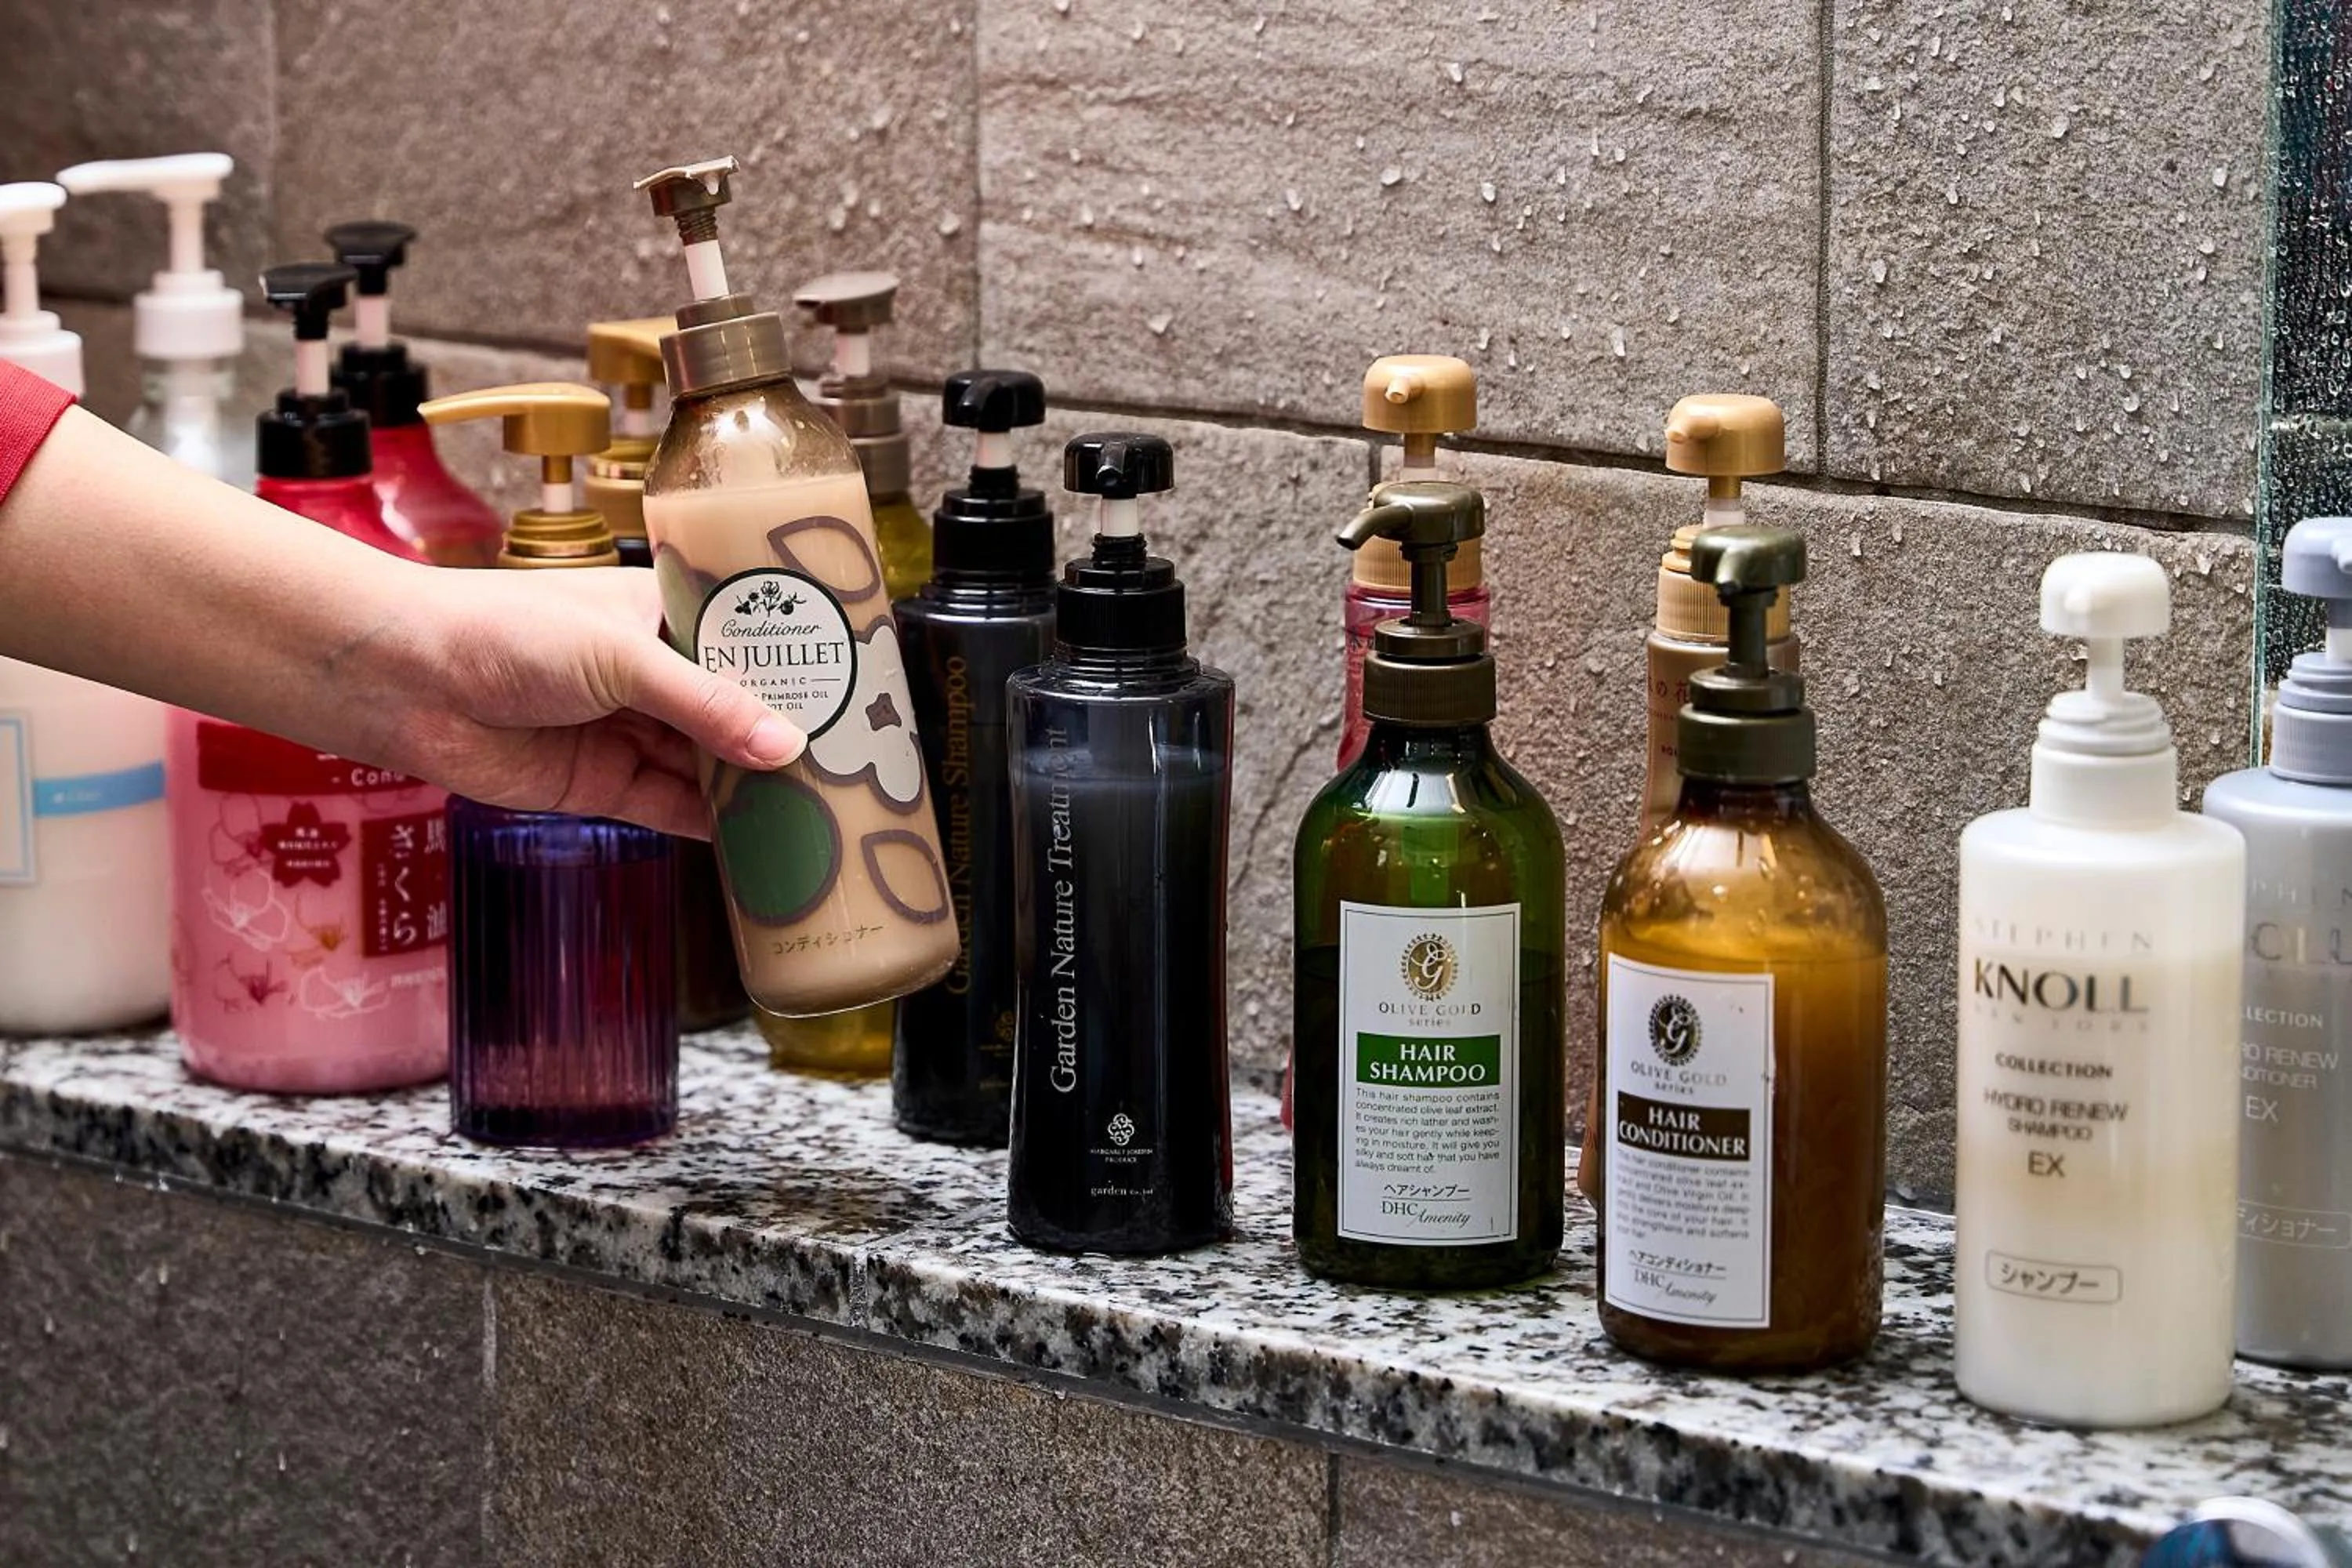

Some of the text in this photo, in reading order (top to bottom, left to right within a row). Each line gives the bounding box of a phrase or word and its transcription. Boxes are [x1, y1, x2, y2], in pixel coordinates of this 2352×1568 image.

[720, 619, 822, 637] Conditioner
[704, 642, 844, 674] EN JUILLET
[740, 677, 808, 688] ORGANIC
[761, 691, 808, 701] PRIMROSE
[942, 656, 976, 783] Shampoo
[947, 794, 971, 883] Nature
[390, 823, 417, 946] さくら
[1047, 727, 1076, 1094] Garden Nature Treatment
[771, 925, 884, 954] コンディショナー
[1974, 957, 2150, 1013] KNOLL
[1379, 1002, 1428, 1015] OLIVE
[1399, 1044, 1456, 1061] HAIR
[2266, 1046, 2339, 1069] RENEW
[1370, 1062, 1486, 1082] SHAMPOO
[1631, 1061, 1727, 1086] OLIVE GOLD
[1994, 1053, 2114, 1079] COLLECTION
[1356, 1087, 1499, 1103] This hair shampoo contains
[1356, 1102, 1417, 1114] concentrated
[1420, 1104, 1443, 1114] olive
[1648, 1106, 1700, 1131] HAIR
[2049, 1099, 2131, 1121] RENEW
[2245, 1095, 2279, 1122] EX
[1363, 1115, 1398, 1125] creates
[1399, 1116, 1418, 1126] rich
[1421, 1116, 1448, 1126] lather
[1451, 1116, 1470, 1126] and
[1368, 1126, 1389, 1136] your
[1392, 1127, 1410, 1136] hair
[1412, 1127, 1442, 1138] gently
[1445, 1128, 1470, 1138] while
[2007, 1117, 2093, 1141] SHAMPOO
[1441, 1141, 1458, 1149] will
[1461, 1142, 1481, 1152] give
[1483, 1140, 1500, 1150] you
[1619, 1120, 1745, 1155] CONDITIONER
[1355, 1160, 1385, 1171] always
[1376, 1149, 1394, 1160] and
[1396, 1151, 1414, 1160] soft
[1437, 1152, 1456, 1163] that
[1459, 1152, 1476, 1163] you
[1478, 1151, 1500, 1160] have
[2027, 1149, 2066, 1178] EX
[1384, 1183, 1470, 1197] ヘアシャンプー
[1381, 1200, 1471, 1229] DHC Amenity
[1629, 1250, 1727, 1275] ヘアコンディショナー
[1634, 1269, 1665, 1288] DHC
[2001, 1263, 2100, 1294] シャンプー
